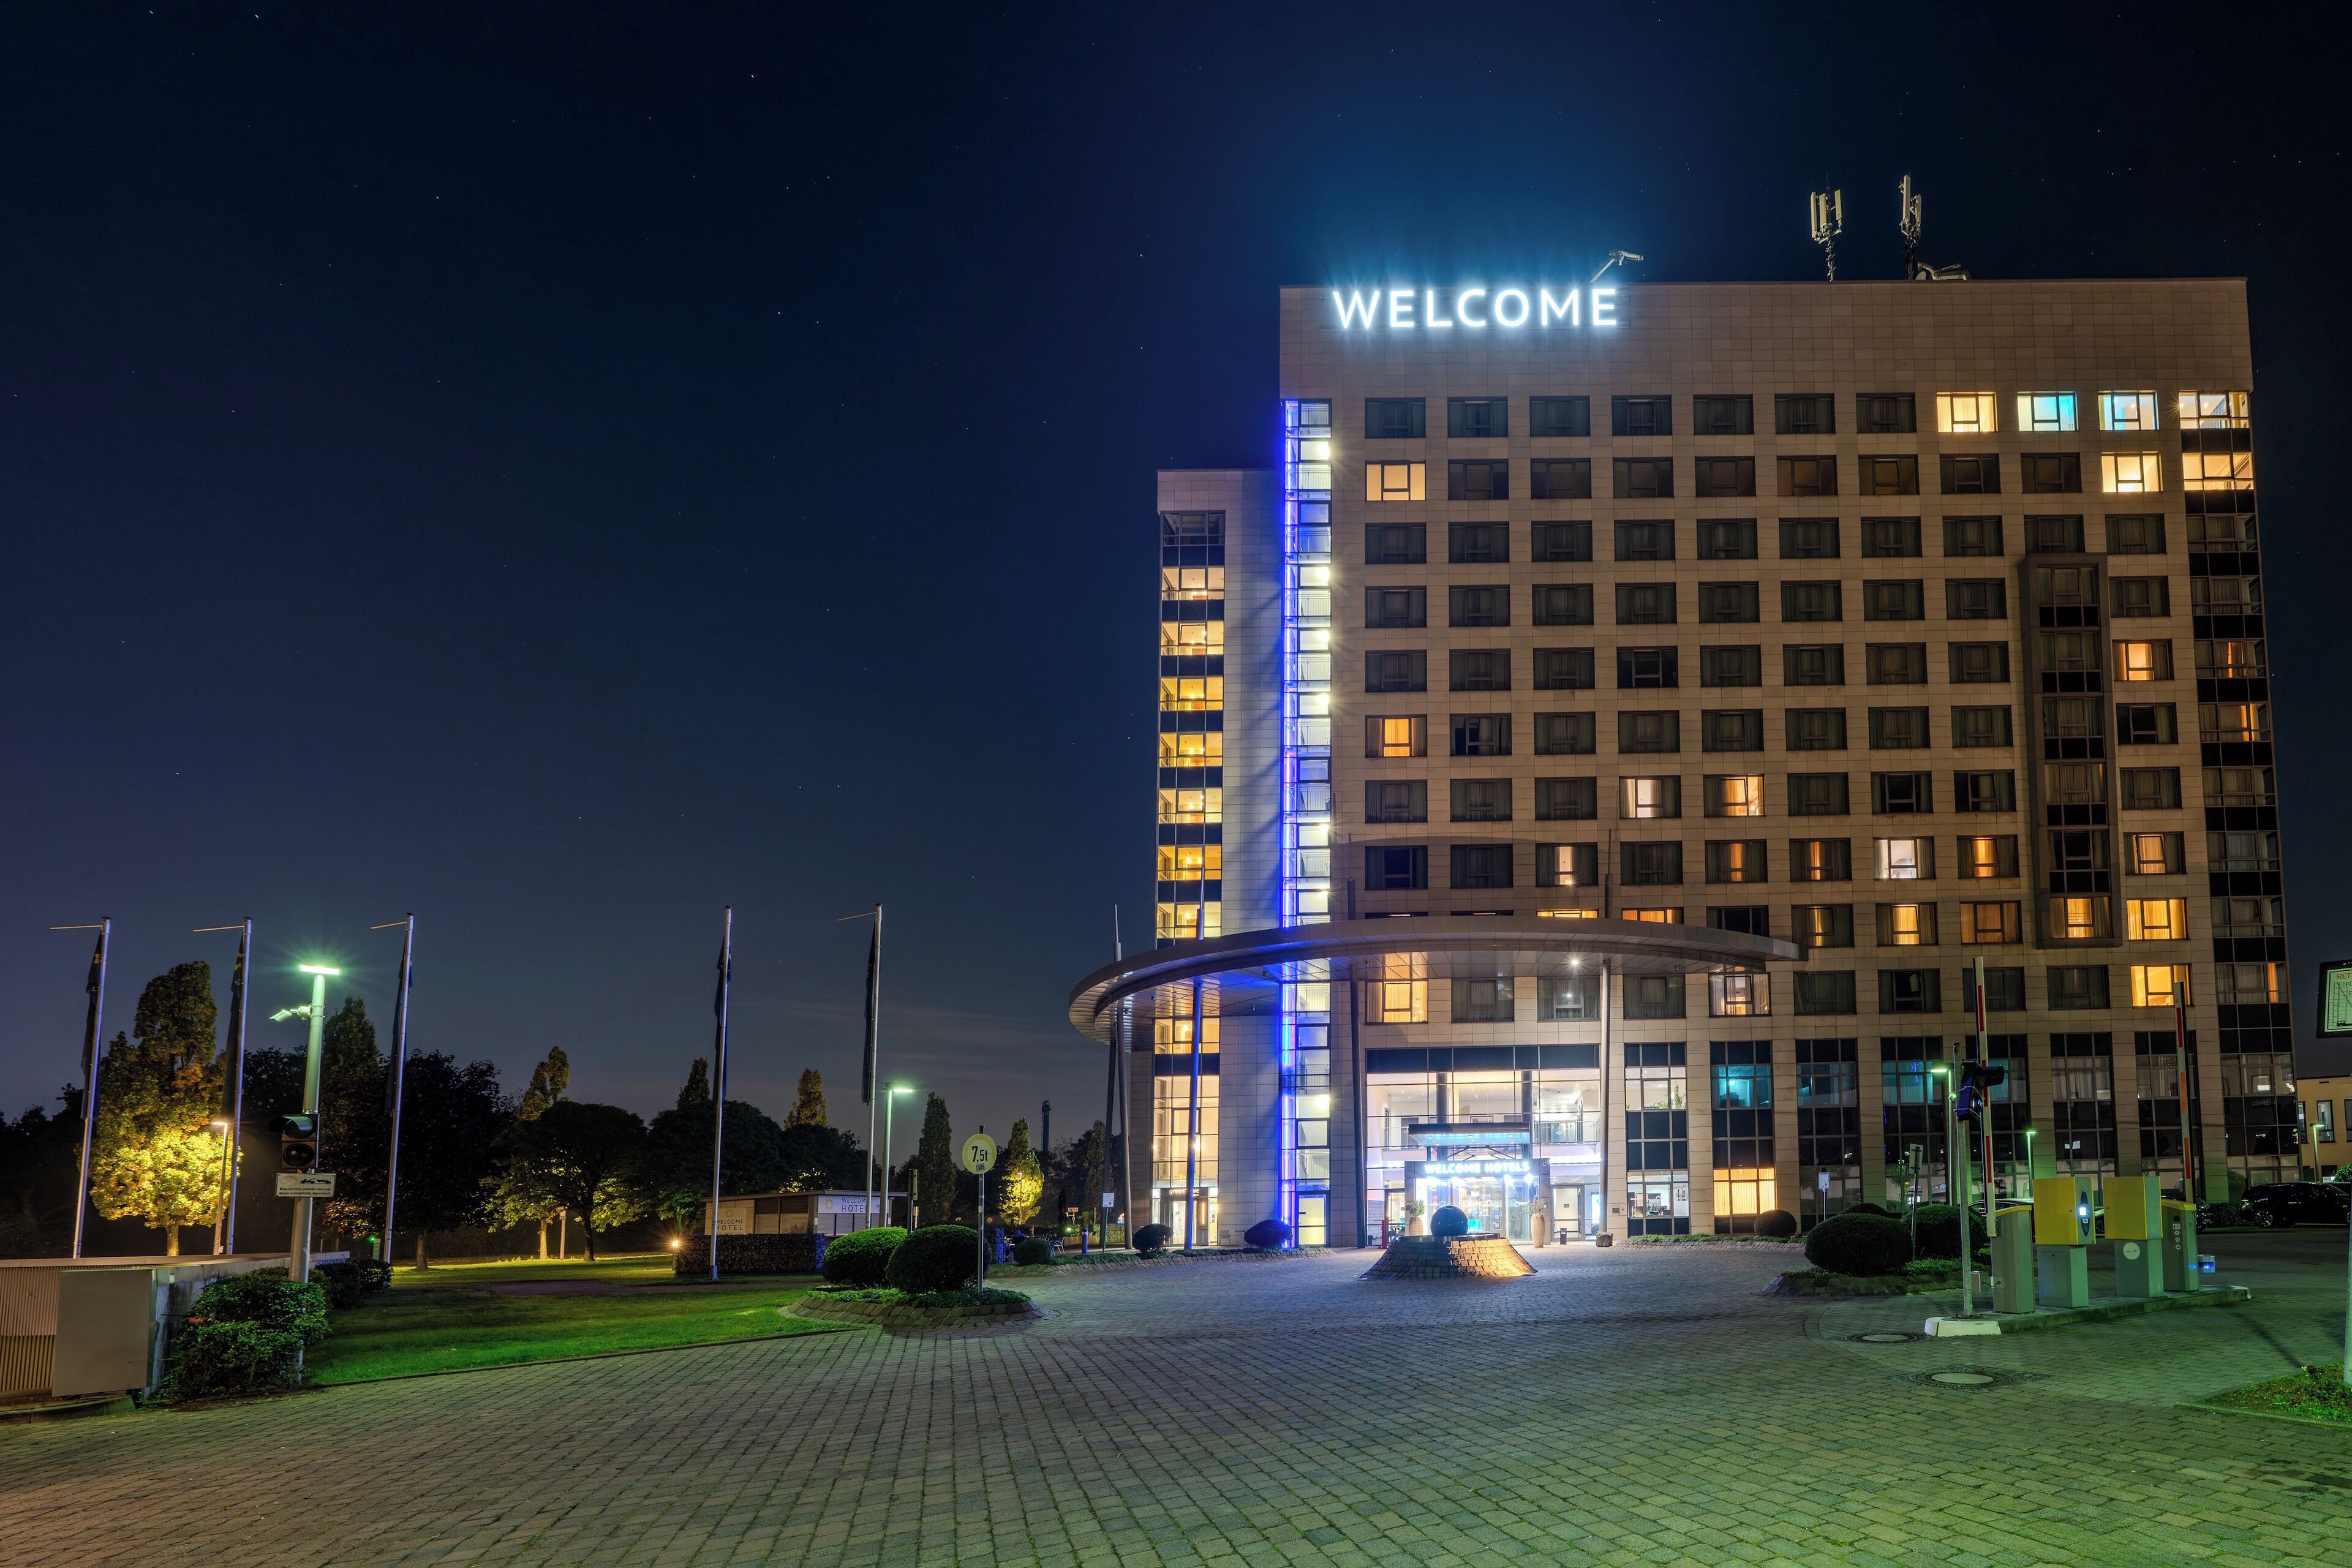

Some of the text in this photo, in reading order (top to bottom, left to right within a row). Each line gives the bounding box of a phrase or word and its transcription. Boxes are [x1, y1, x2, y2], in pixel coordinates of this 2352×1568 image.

[1332, 288, 1617, 329] WELCOME
[971, 1145, 989, 1164] 7,5t
[1424, 1161, 1530, 1174] WELCOME HOTELS
